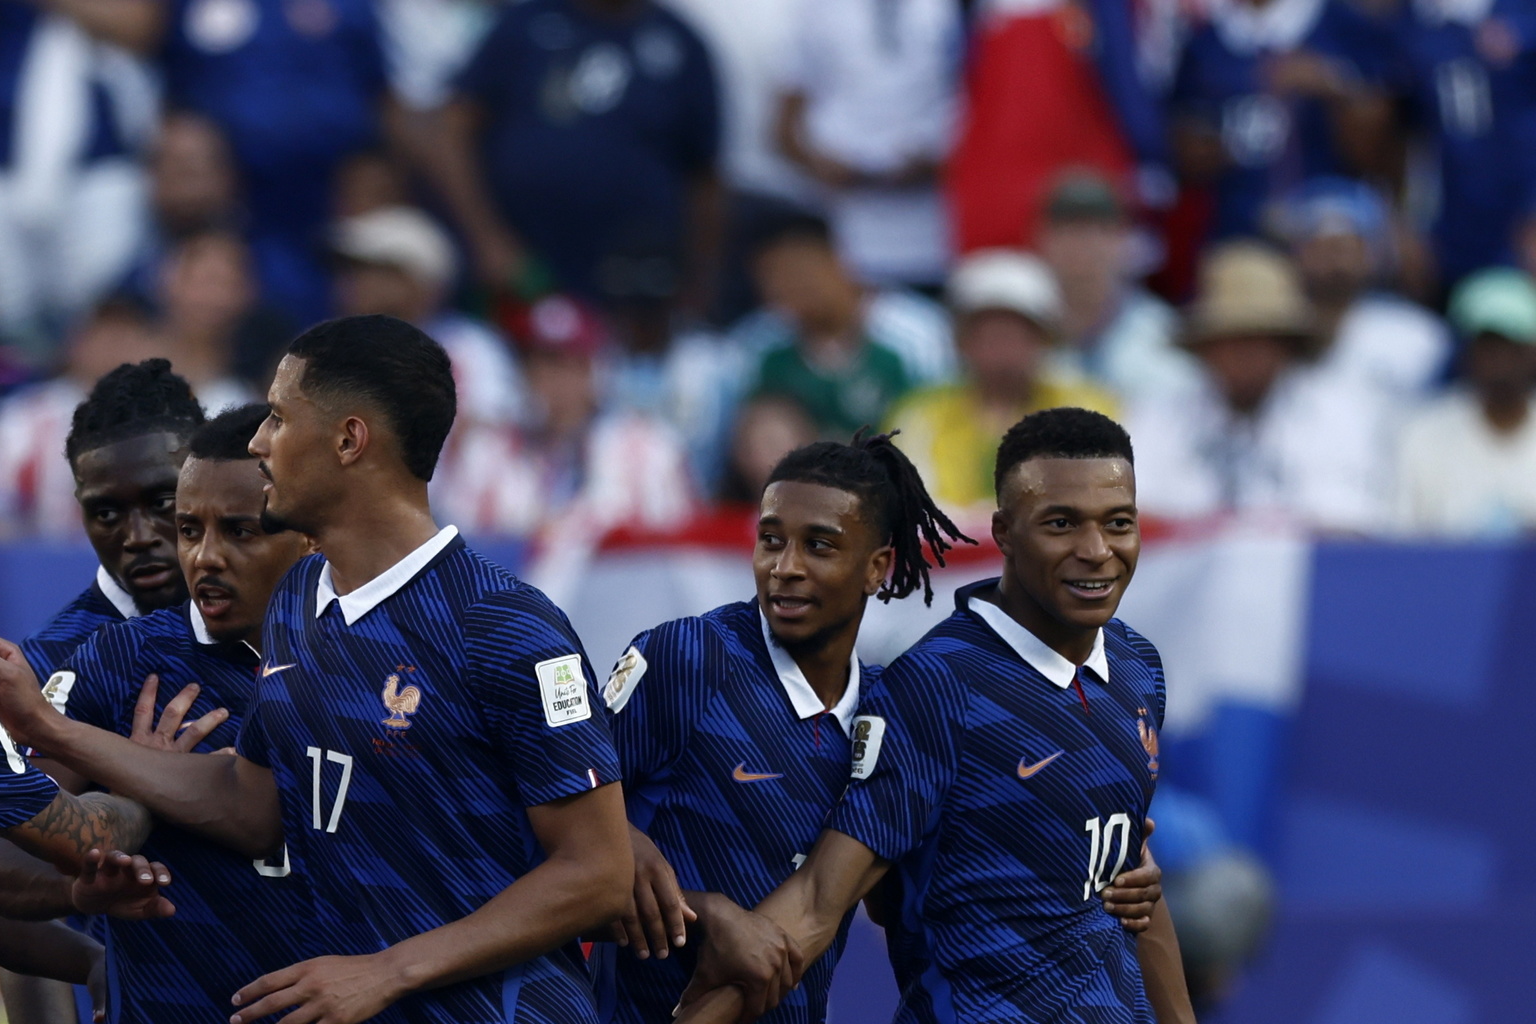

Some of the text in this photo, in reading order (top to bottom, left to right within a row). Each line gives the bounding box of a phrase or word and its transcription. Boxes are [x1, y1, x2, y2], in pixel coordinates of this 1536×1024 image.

[552, 696, 582, 712] EDUCATION
[306, 745, 353, 834] 17
[1083, 813, 1131, 902] 10
